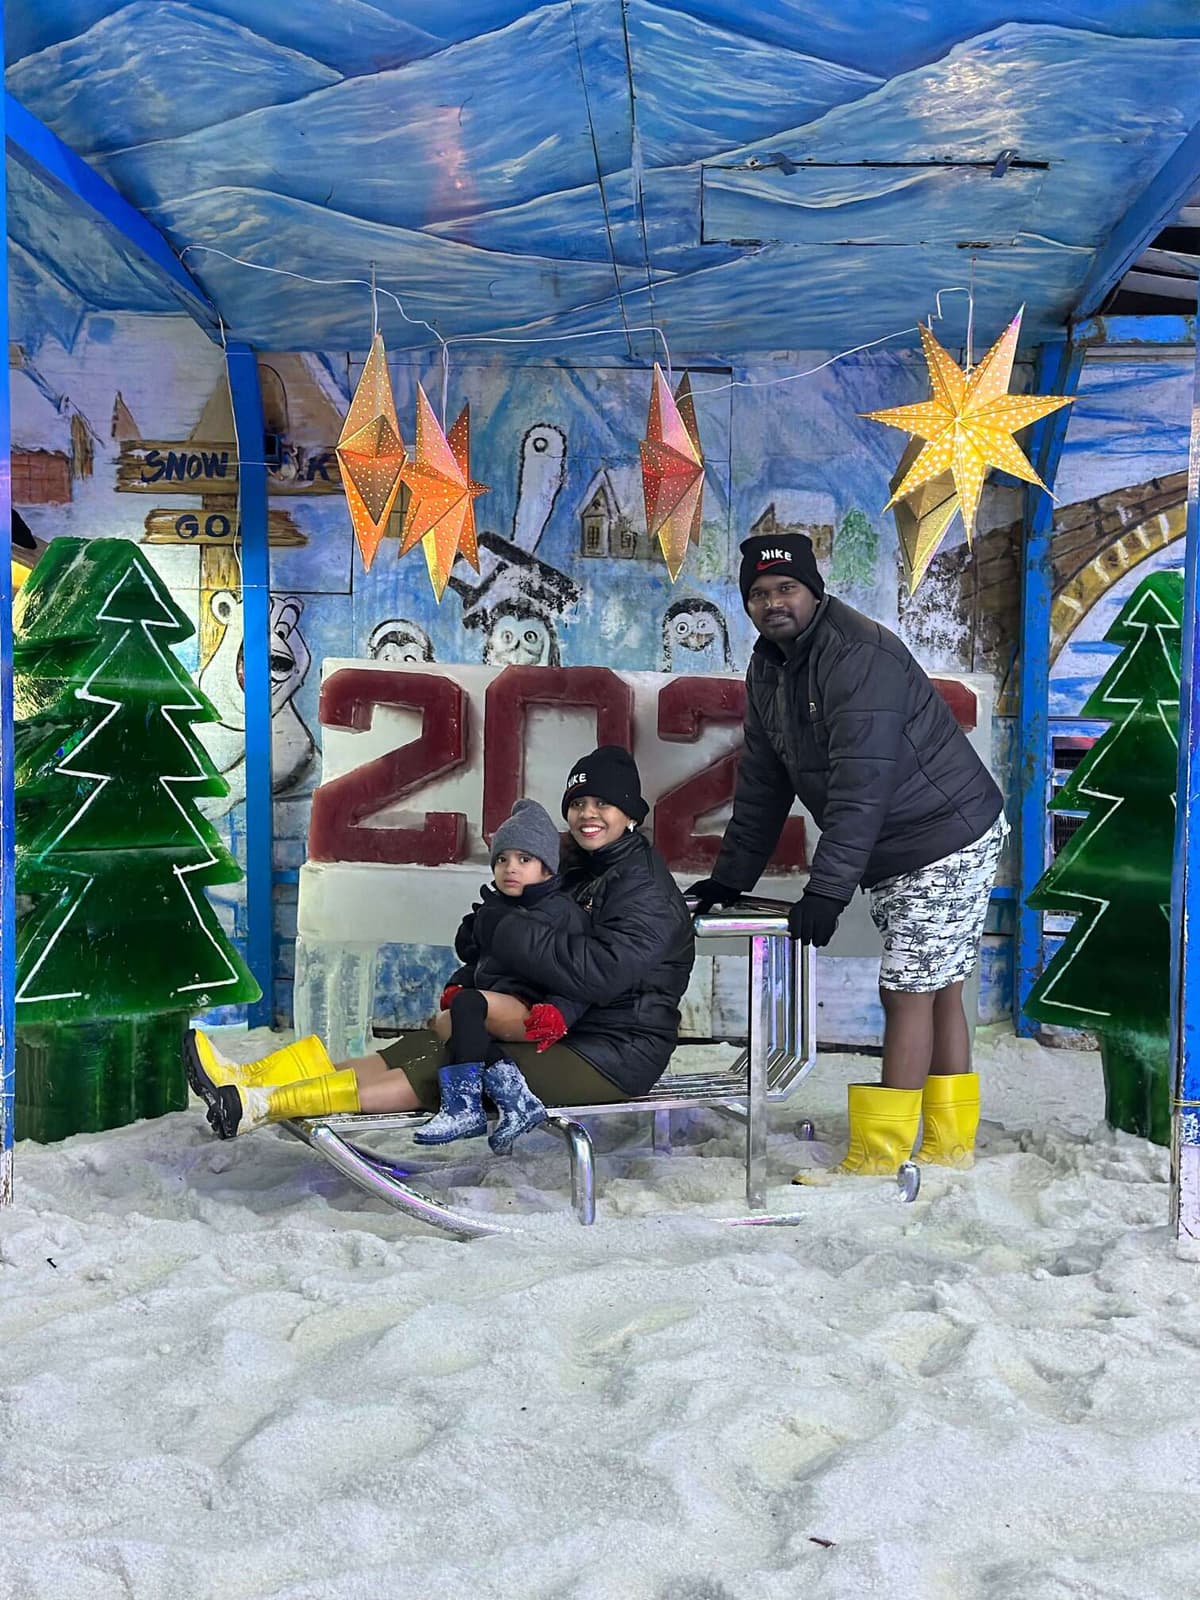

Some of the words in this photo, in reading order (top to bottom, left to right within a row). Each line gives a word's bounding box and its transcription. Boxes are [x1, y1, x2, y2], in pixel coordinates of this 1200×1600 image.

[141, 450, 229, 482] SNOW
[175, 514, 242, 539] GO
[760, 548, 793, 561] NIKE
[307, 664, 978, 876] 202
